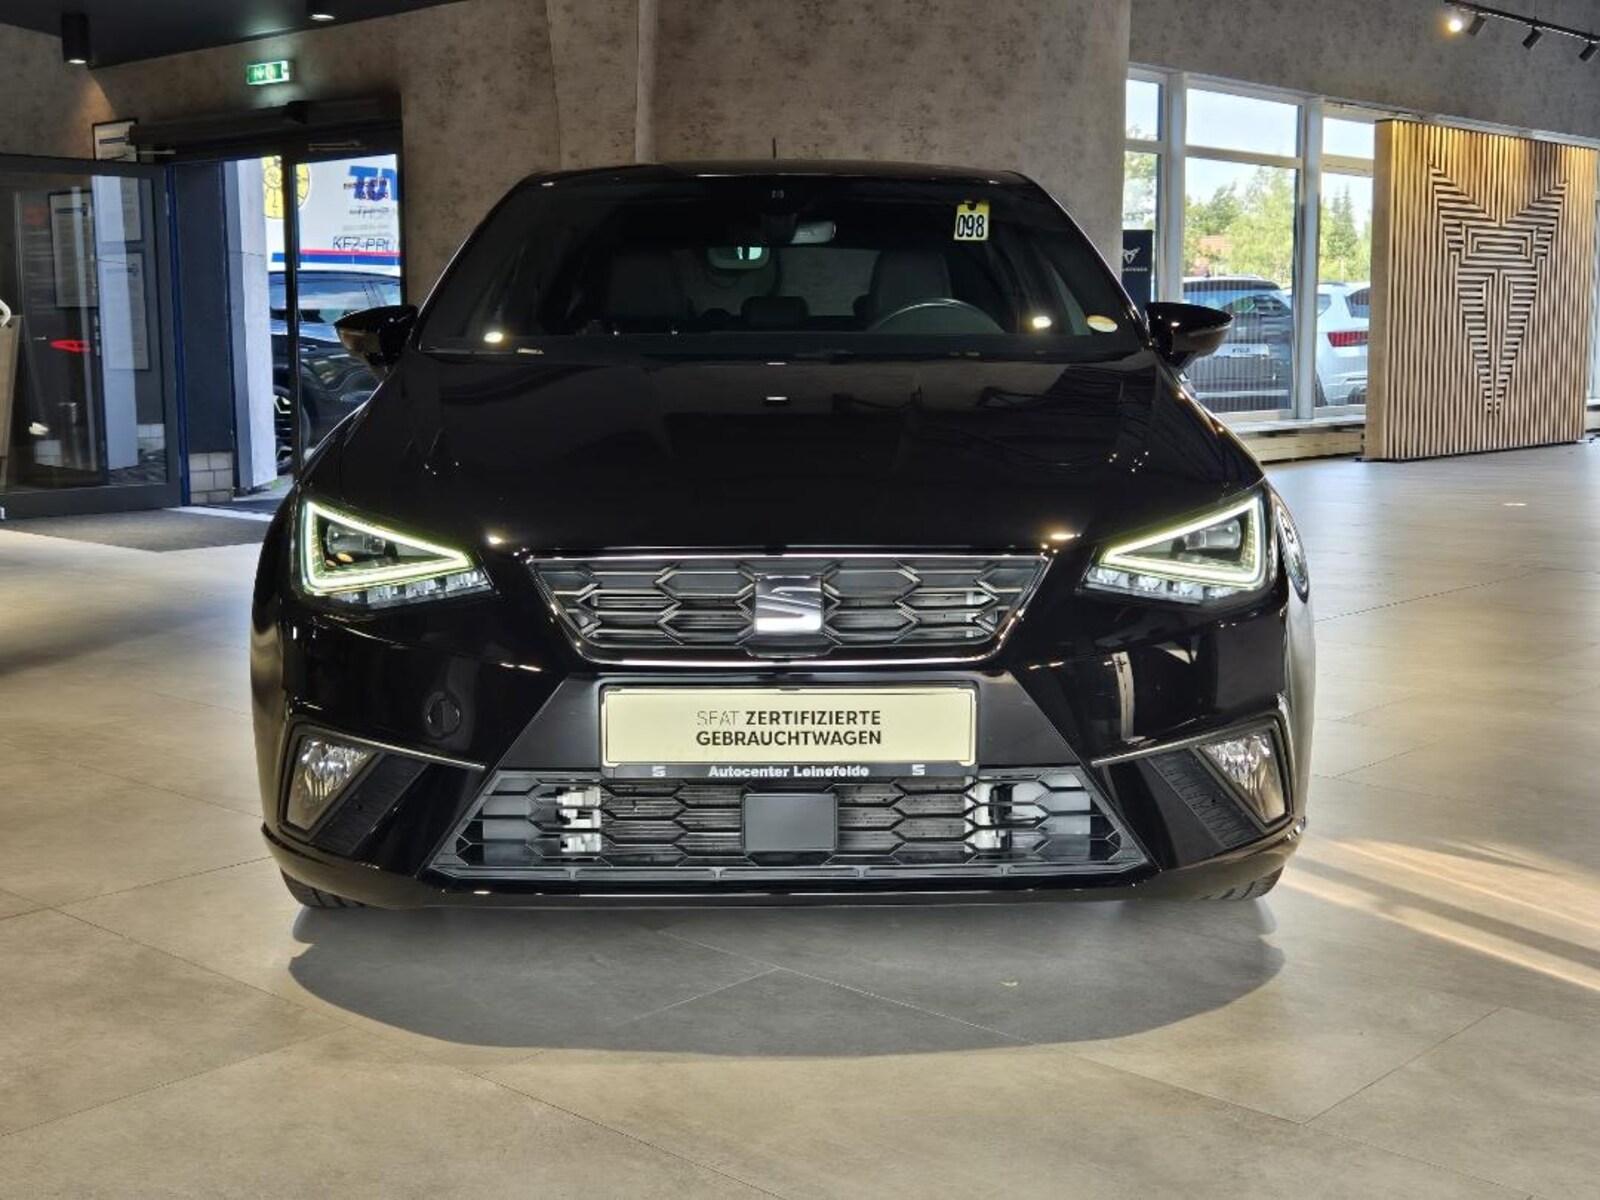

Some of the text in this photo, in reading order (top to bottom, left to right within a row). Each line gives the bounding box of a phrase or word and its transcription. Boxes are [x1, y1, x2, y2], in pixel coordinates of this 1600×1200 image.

[956, 214, 985, 238] 098
[696, 710, 881, 726] SEAT ZERTIFIZIERTE
[696, 730, 881, 746] GEBRAUCHTWAGEN
[708, 765, 870, 778] Autocenter Leinefelde
